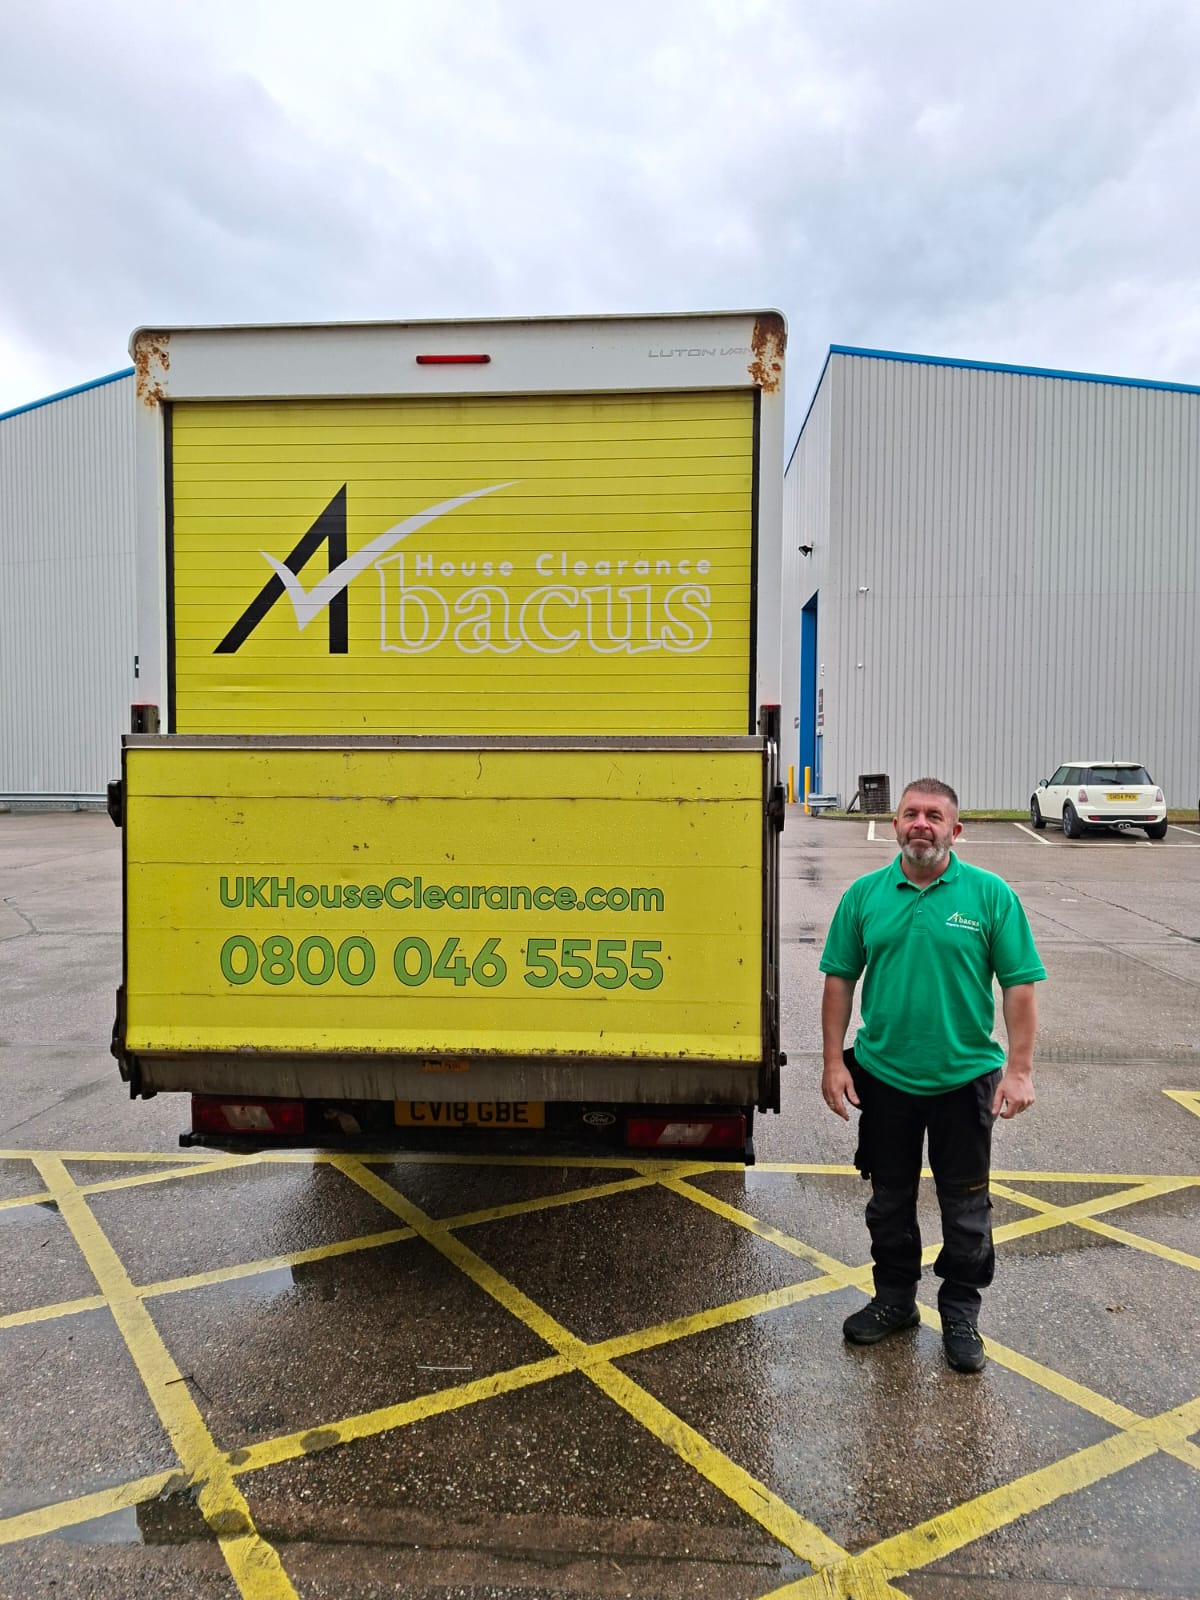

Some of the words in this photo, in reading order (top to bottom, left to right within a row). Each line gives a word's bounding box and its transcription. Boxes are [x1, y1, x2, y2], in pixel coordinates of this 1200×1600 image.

[648, 348, 716, 358] LUTON
[415, 553, 514, 577] House
[535, 552, 712, 576] Clearance
[219, 876, 665, 912] UKHouseClearance.com
[220, 935, 376, 986] 0800
[393, 936, 508, 988] 046
[523, 938, 664, 991] 5555
[410, 1102, 469, 1122] CV18
[477, 1102, 529, 1124] GBE
